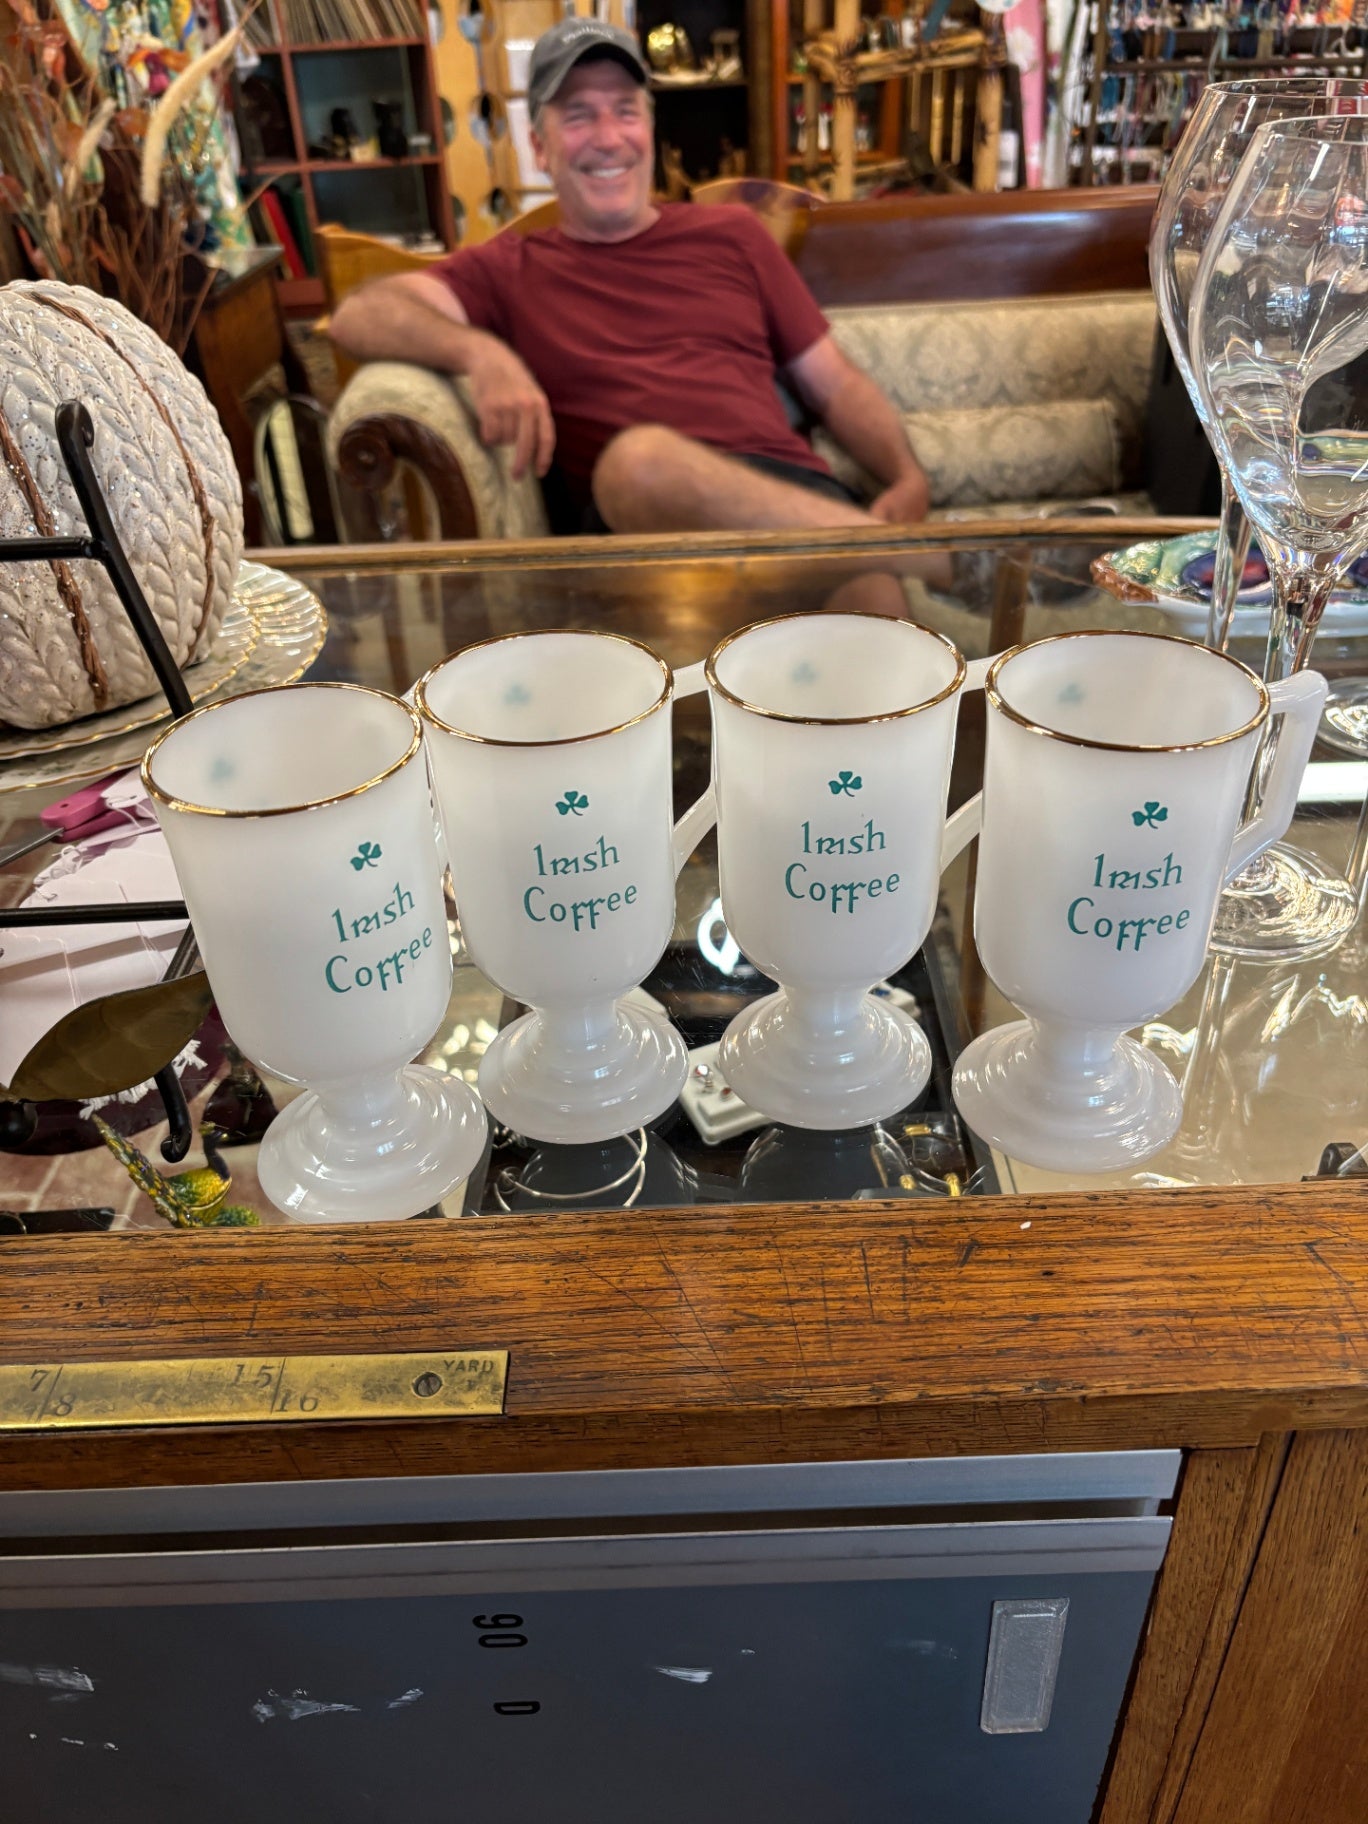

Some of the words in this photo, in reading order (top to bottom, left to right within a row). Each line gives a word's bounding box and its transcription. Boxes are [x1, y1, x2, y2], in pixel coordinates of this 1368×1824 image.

[535, 837, 619, 876] Irish
[803, 821, 886, 855] Irish
[785, 863, 900, 913] Coffee
[1094, 854, 1182, 891] Irish
[332, 883, 414, 943] Irish
[524, 885, 637, 931] Coffee
[1067, 897, 1190, 952] Coffee
[324, 928, 432, 993] Coffee
[443, 1360, 494, 1373] YARD
